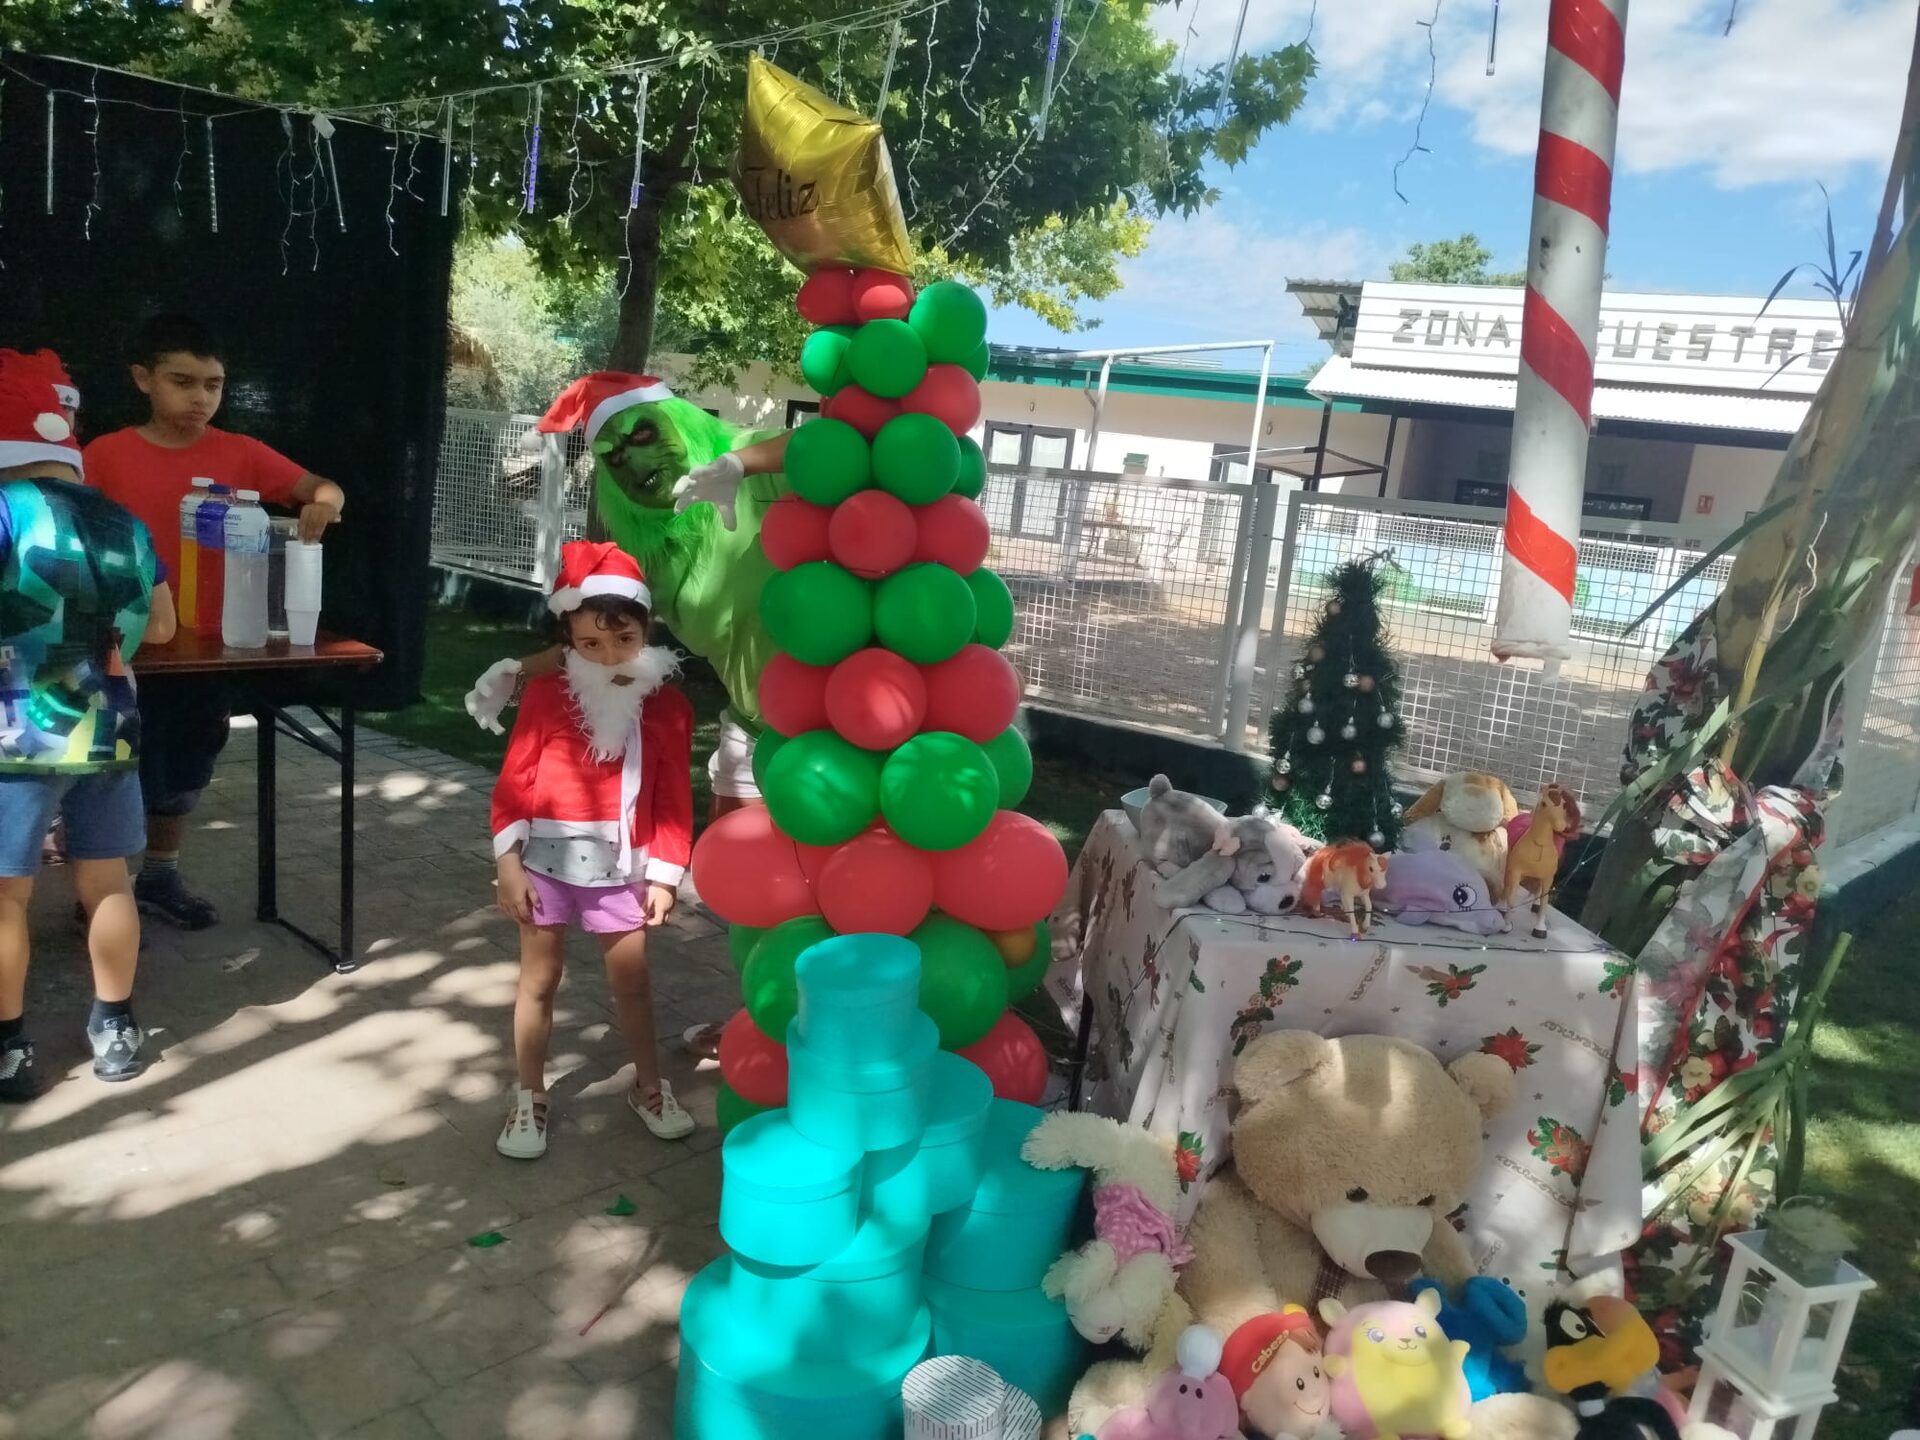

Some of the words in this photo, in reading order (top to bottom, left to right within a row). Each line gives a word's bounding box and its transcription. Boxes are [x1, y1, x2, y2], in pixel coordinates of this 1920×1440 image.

[745, 166, 820, 220] Feliz
[1392, 308, 1511, 348] ZONA
[1597, 319, 1837, 370] UESTRE
